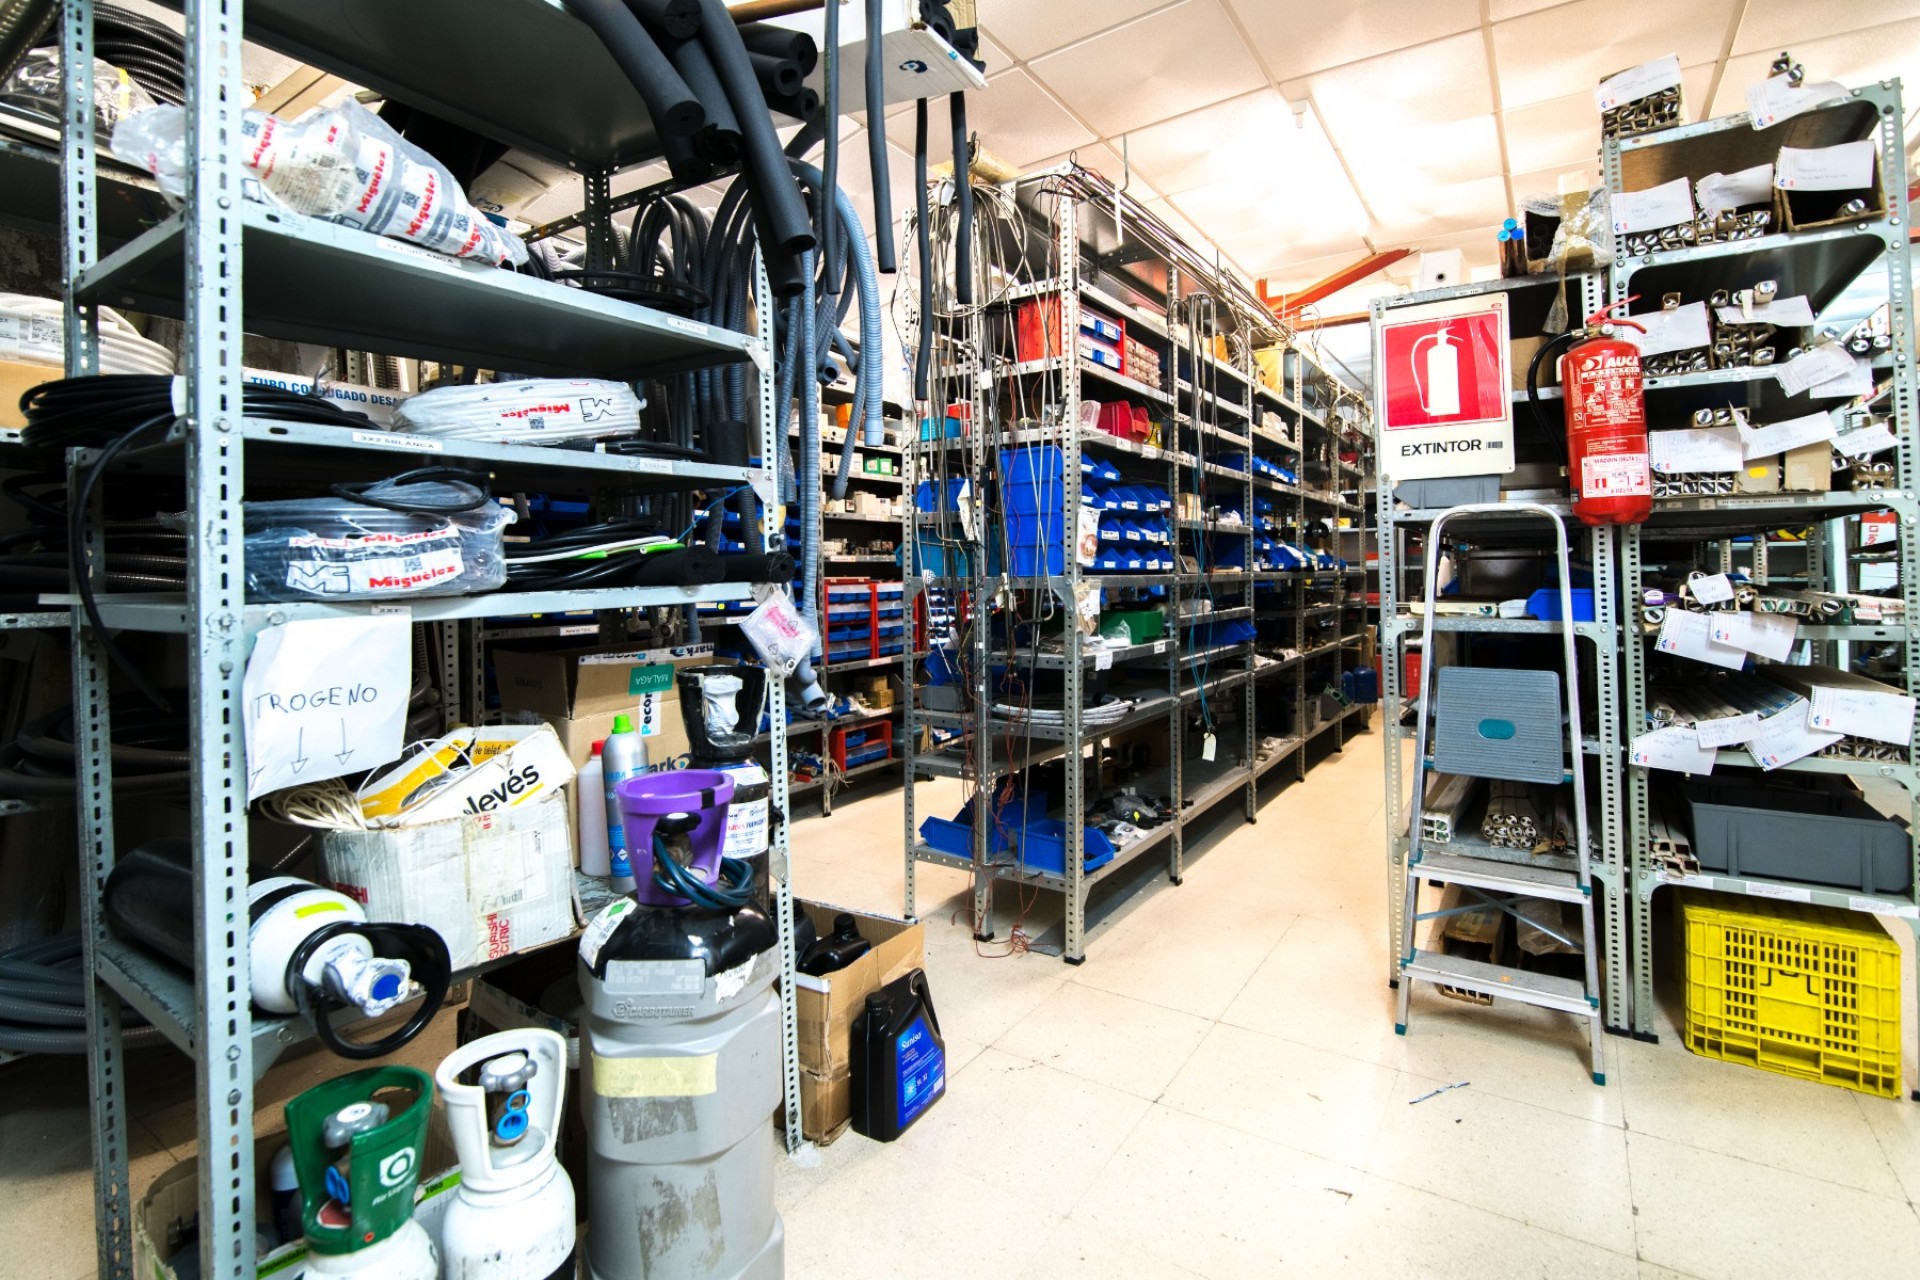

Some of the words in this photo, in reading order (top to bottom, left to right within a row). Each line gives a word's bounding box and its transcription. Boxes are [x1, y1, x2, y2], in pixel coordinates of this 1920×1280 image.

[291, 382, 368, 402] COUGADO
[1401, 438, 1482, 457] EXTINTOR
[255, 683, 378, 719] TROGENO
[463, 764, 540, 815] levés
